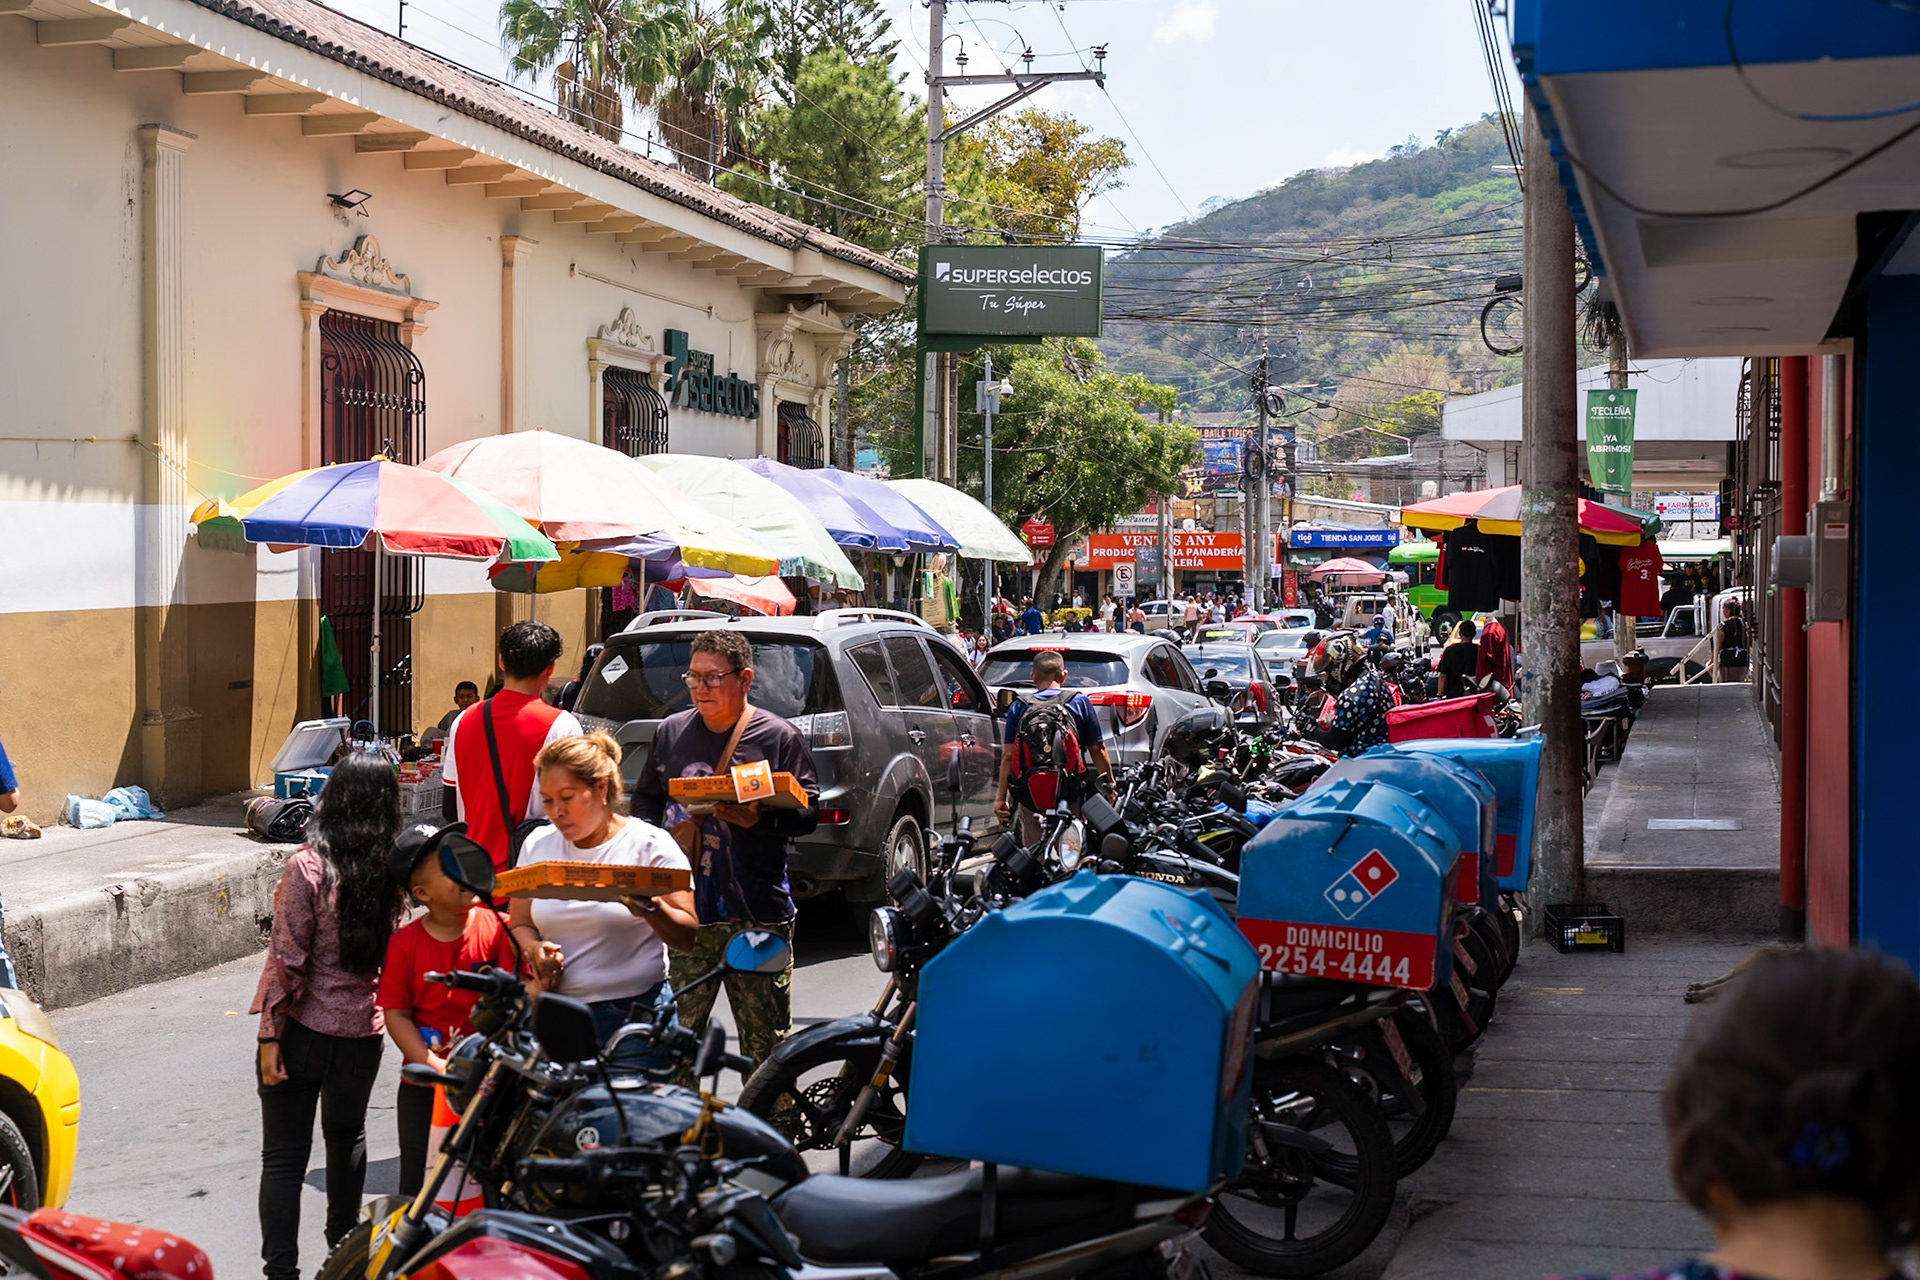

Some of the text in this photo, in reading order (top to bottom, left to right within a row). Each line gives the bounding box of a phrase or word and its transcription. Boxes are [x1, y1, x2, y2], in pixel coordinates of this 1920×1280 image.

[979, 294, 1046, 316] Tu Súper
[689, 350, 711, 368] SUPER
[1591, 405, 1631, 416] TECLEÑA
[1204, 429, 1225, 437] BAILE
[1603, 434, 1618, 444] ¡YA
[1590, 445, 1631, 453] ABRIMOS!
[1129, 515, 1158, 524] Pasteler
[1122, 535, 1216, 546] VENTS ANY
[1348, 534, 1362, 542] SAN
[1363, 534, 1383, 542] JORGE
[1092, 548, 1136, 557] PRODUC
[1185, 546, 1243, 557] PANADERÍA
[1286, 926, 1383, 953] DOMICILIO
[1258, 943, 1411, 984] 2254-4444
